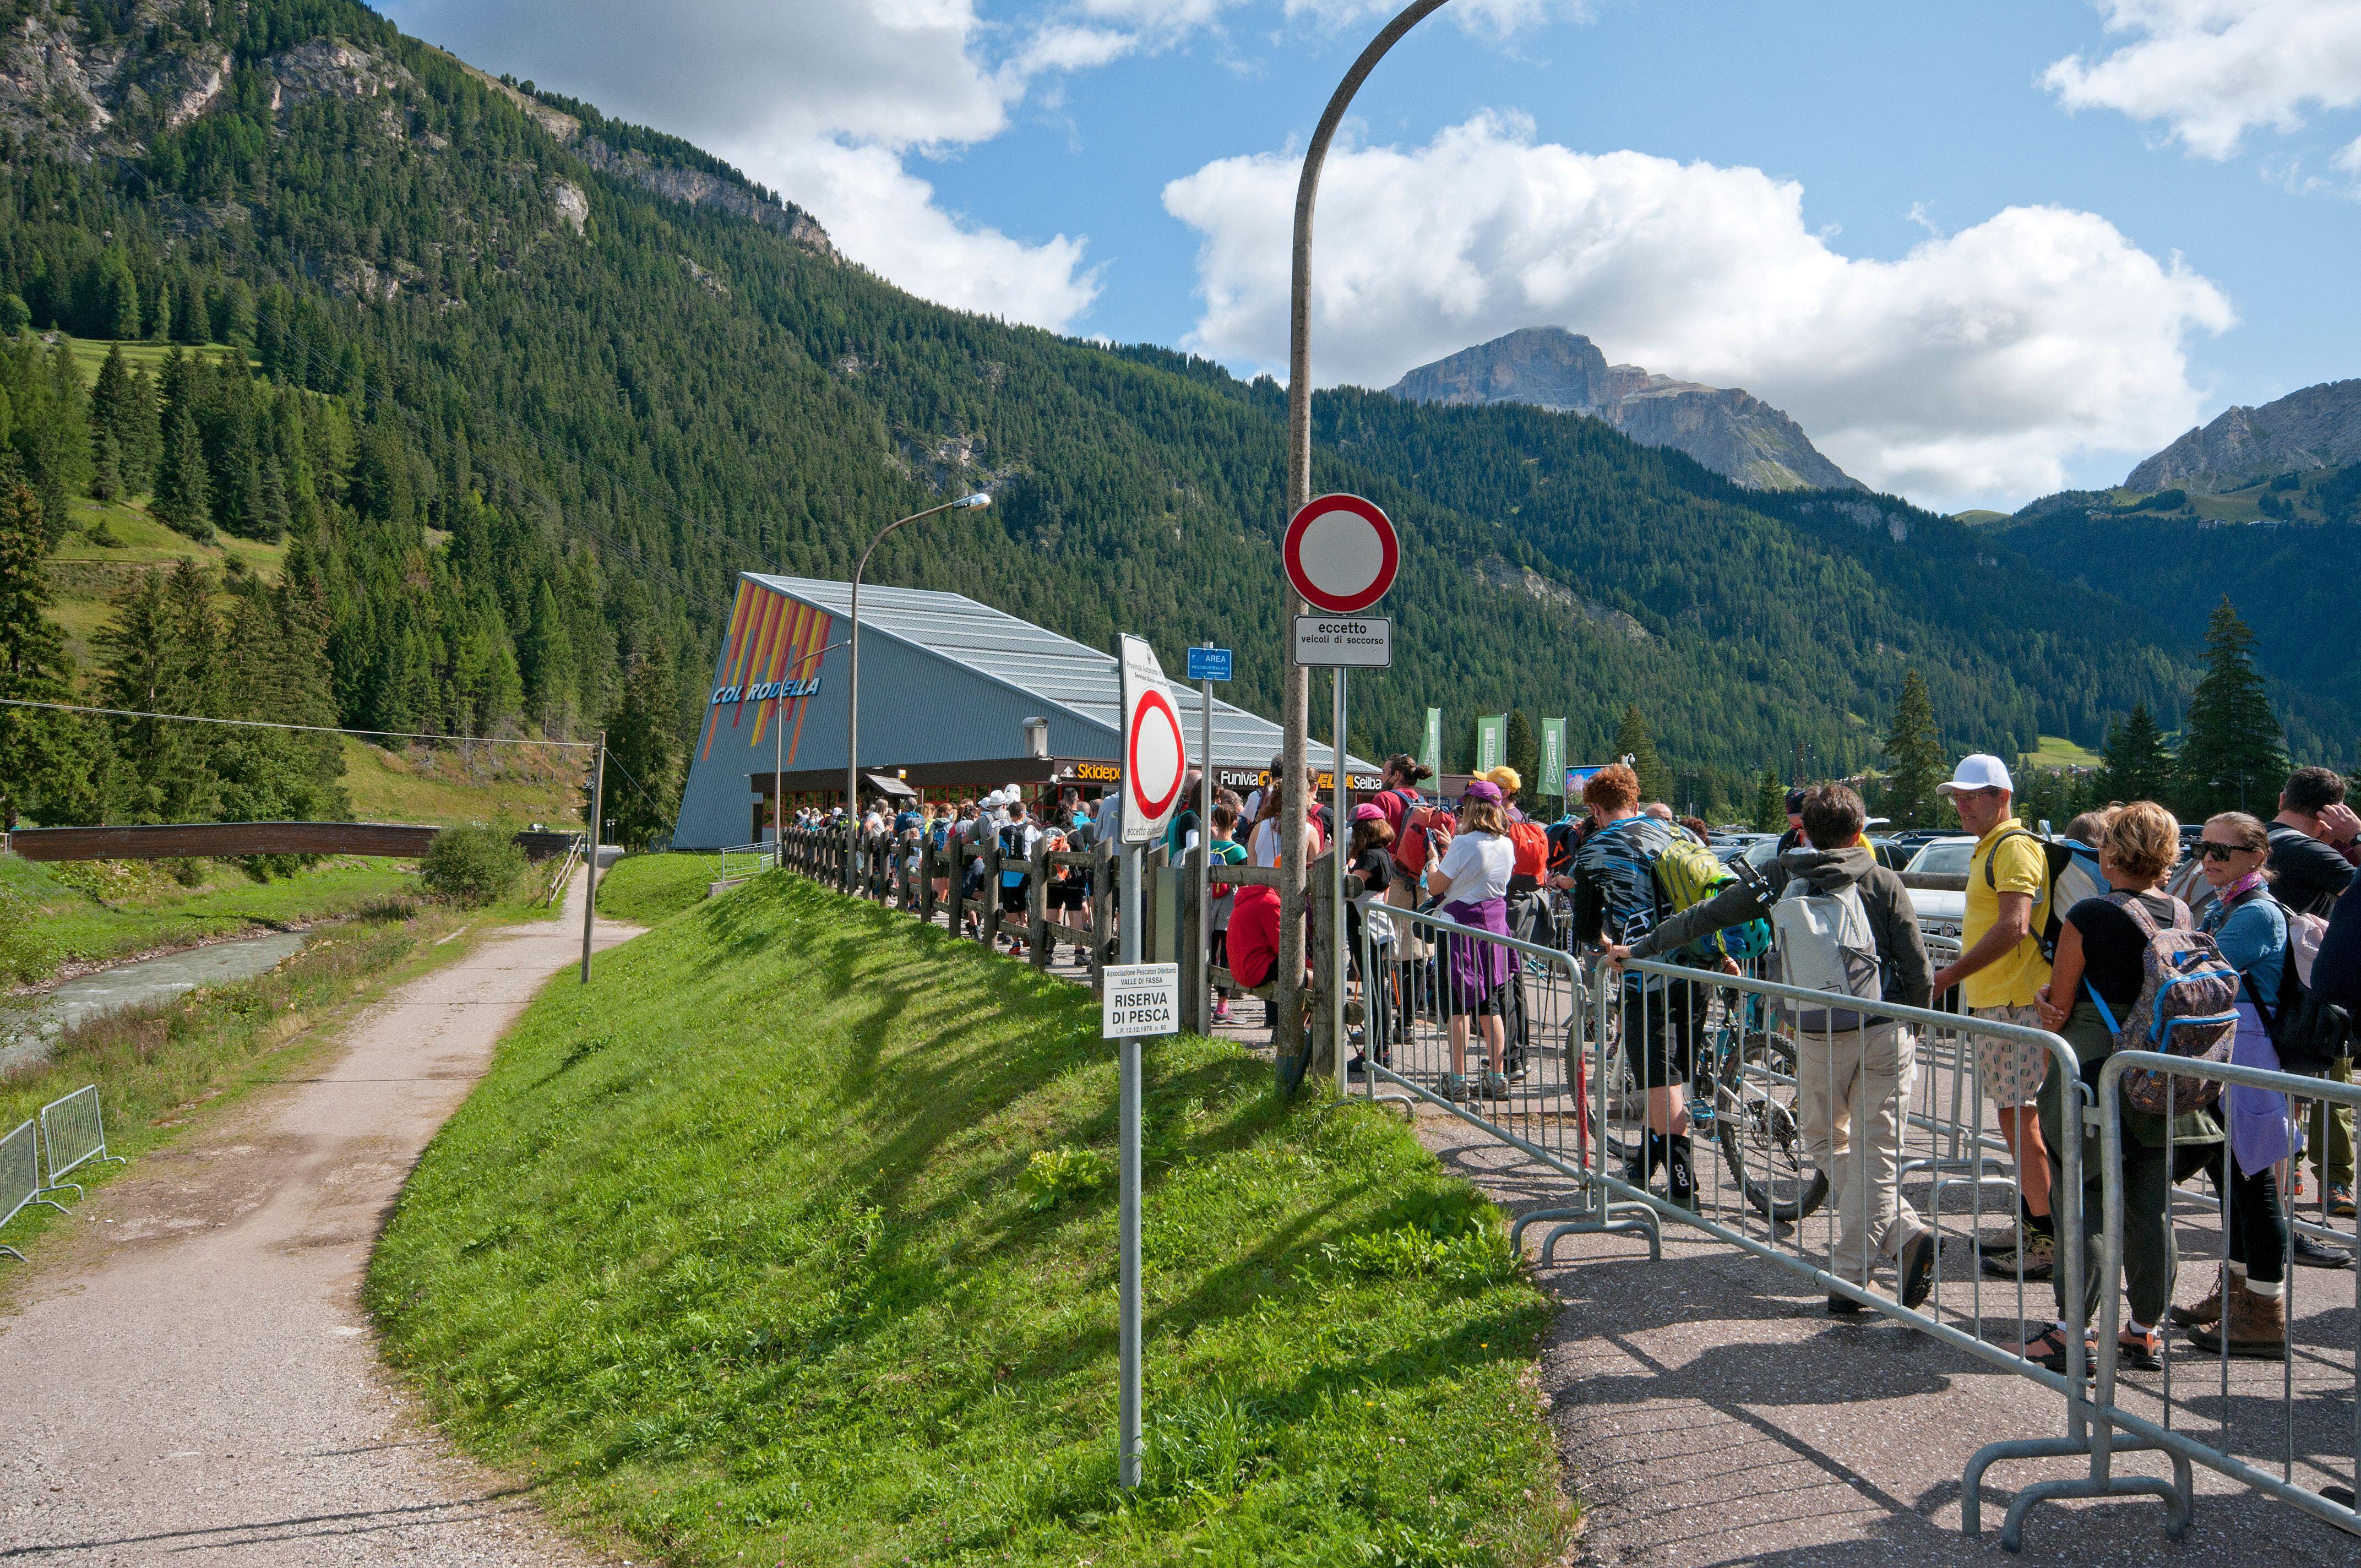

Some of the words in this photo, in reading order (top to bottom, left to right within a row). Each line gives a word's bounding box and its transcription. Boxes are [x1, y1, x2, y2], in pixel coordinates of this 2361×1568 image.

[1318, 622, 1367, 634] eccetto
[1302, 635, 1329, 644] veicoli
[1334, 635, 1342, 644] di
[1205, 655, 1226, 663] AREA
[1127, 660, 1142, 671] Provincia
[712, 685, 743, 705] COL
[746, 677, 822, 701] RODELLA
[1221, 770, 1258, 786] Funivia
[1128, 826, 1146, 836] eccetto
[1115, 992, 1167, 1008] RISERVA
[1112, 1011, 1125, 1025] DI
[1129, 1008, 1170, 1023] PESCA
